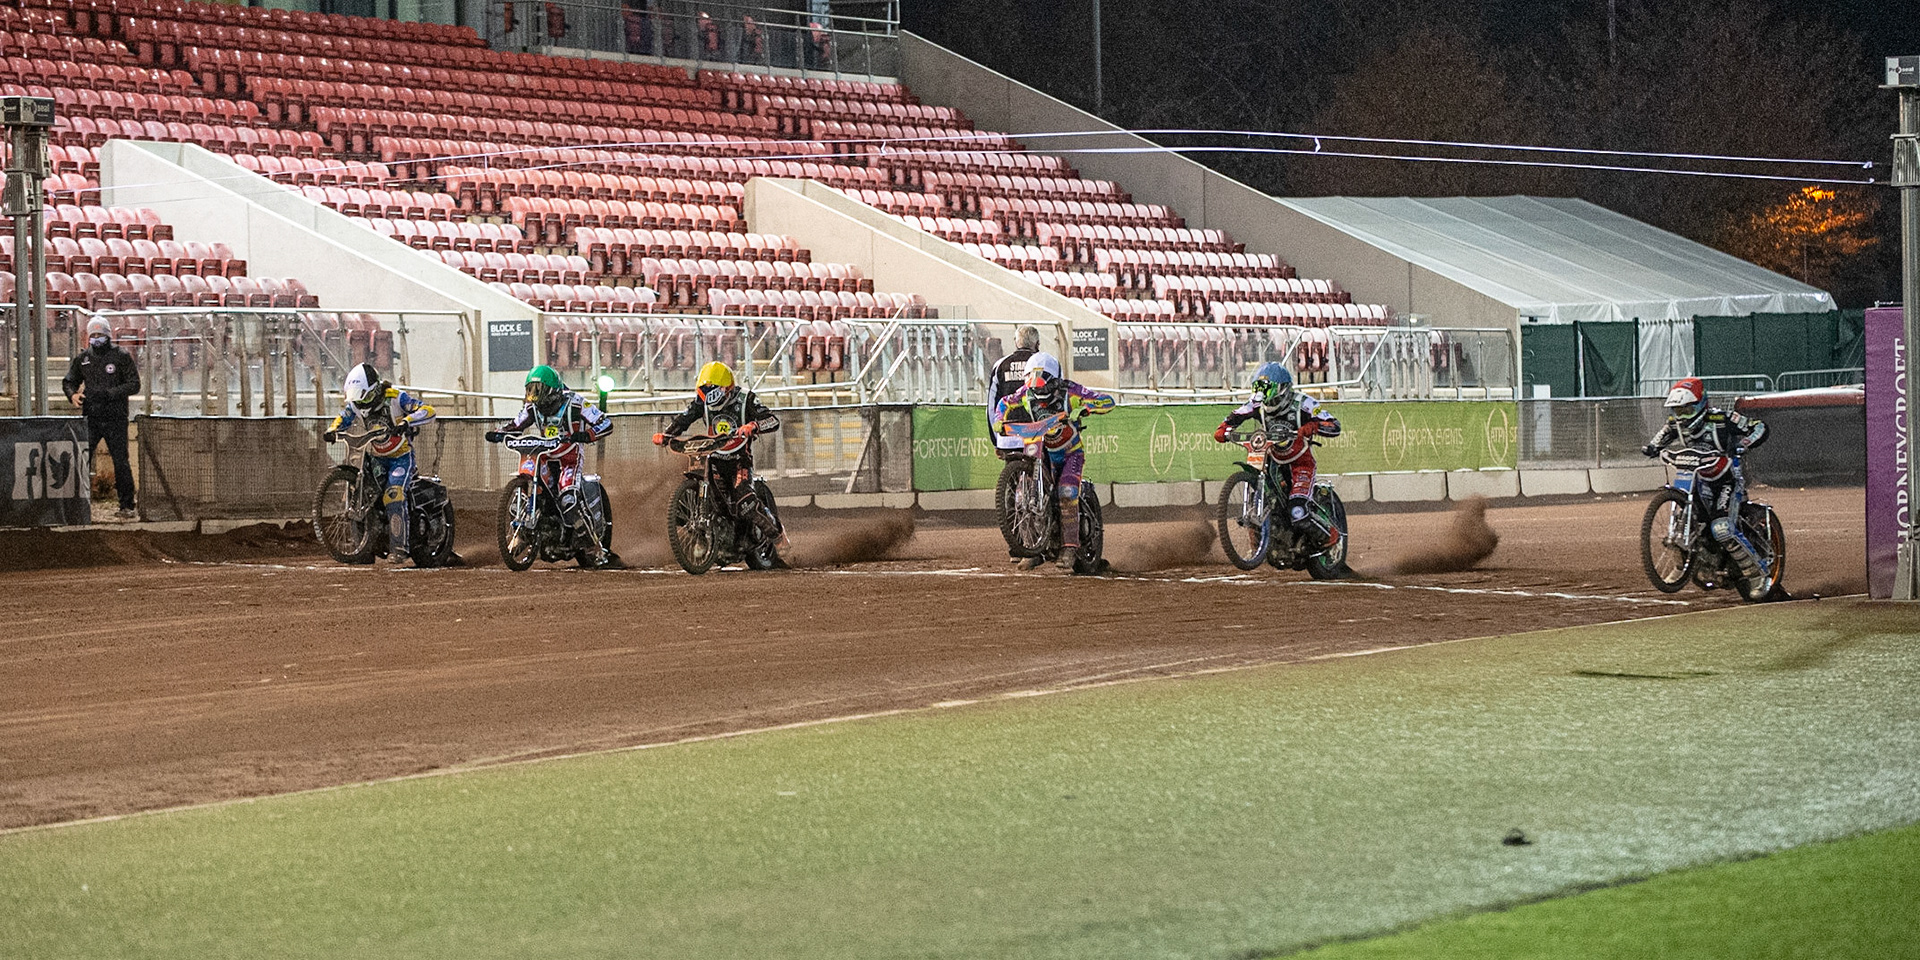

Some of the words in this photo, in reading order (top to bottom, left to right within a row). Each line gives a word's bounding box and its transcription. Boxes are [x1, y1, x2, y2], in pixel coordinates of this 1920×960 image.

[490, 324, 515, 333] BLOCK
[516, 323, 522, 332] E
[1086, 434, 1119, 455] EVENTS
[1177, 432, 1213, 452] SPORTS
